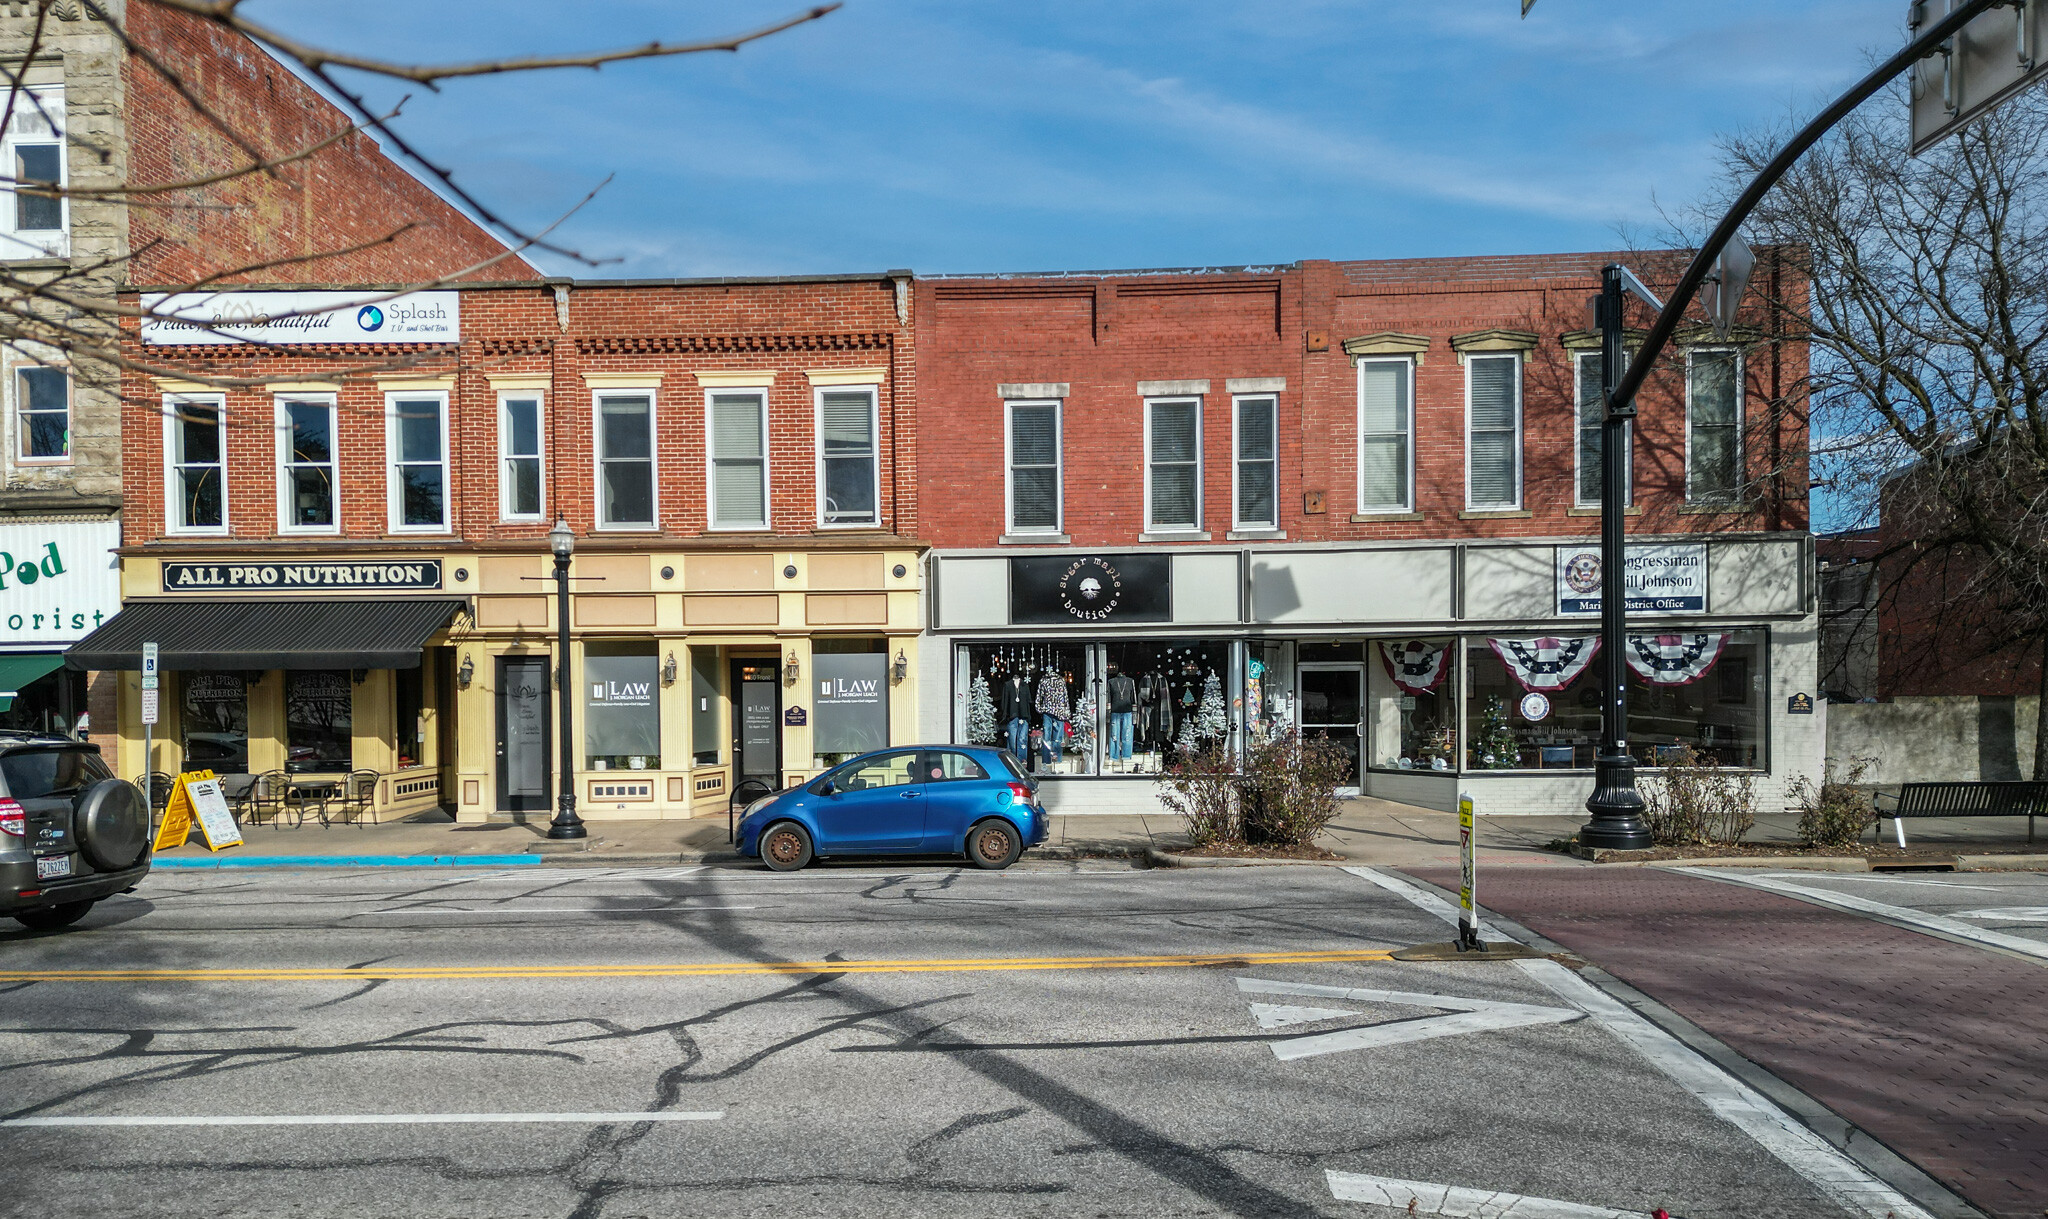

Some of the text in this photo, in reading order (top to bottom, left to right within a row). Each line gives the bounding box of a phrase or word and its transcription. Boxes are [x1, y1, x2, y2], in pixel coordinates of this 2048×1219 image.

[389, 303, 447, 323] Splash
[1624, 555, 1698, 570] ngressman
[177, 565, 423, 585] ALL PRO NUTRITION
[1060, 557, 1121, 588] sugar maple
[1626, 574, 1692, 591] ill Johnson
[1064, 600, 1118, 620] boutique
[1657, 598, 1684, 608] Office
[190, 675, 240, 690] ALL PRO
[610, 681, 650, 695] LAW
[837, 678, 877, 693] LAW
[189, 688, 242, 698] NUTRITION
[1551, 725, 1577, 735] Johnson
